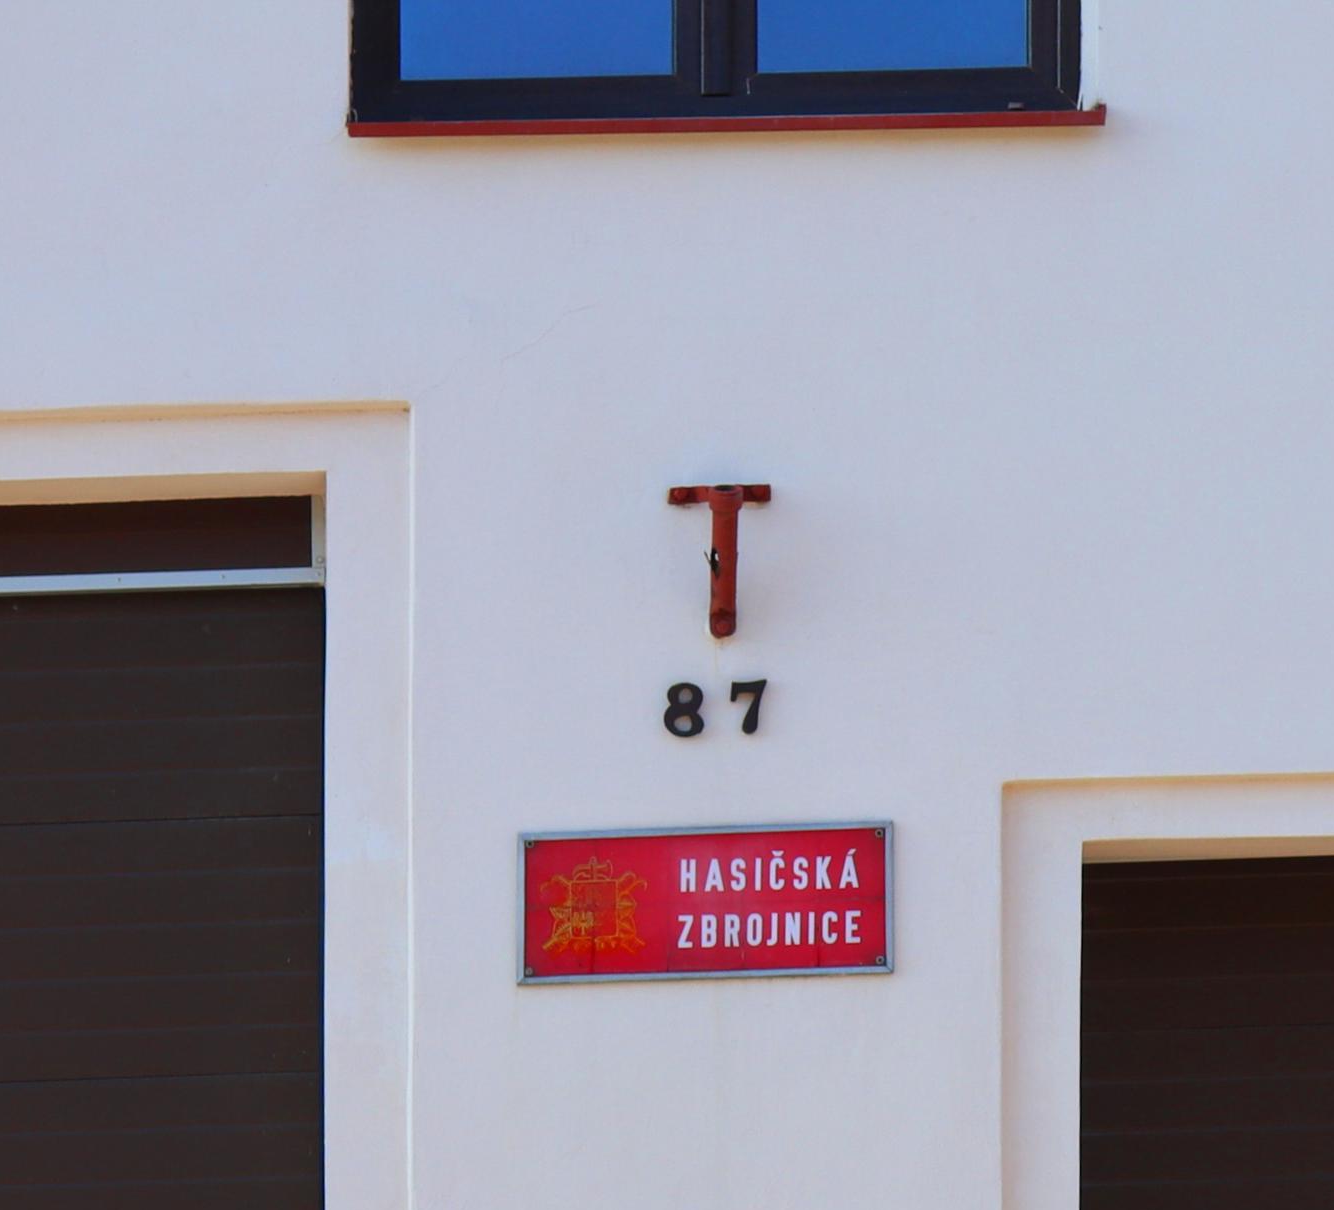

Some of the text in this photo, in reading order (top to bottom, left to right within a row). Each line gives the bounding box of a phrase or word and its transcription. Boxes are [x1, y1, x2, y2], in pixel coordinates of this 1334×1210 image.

[663, 678, 768, 738] 87
[679, 848, 860, 893] HASIČSKÁ
[677, 910, 862, 949] ZBROJNICE
